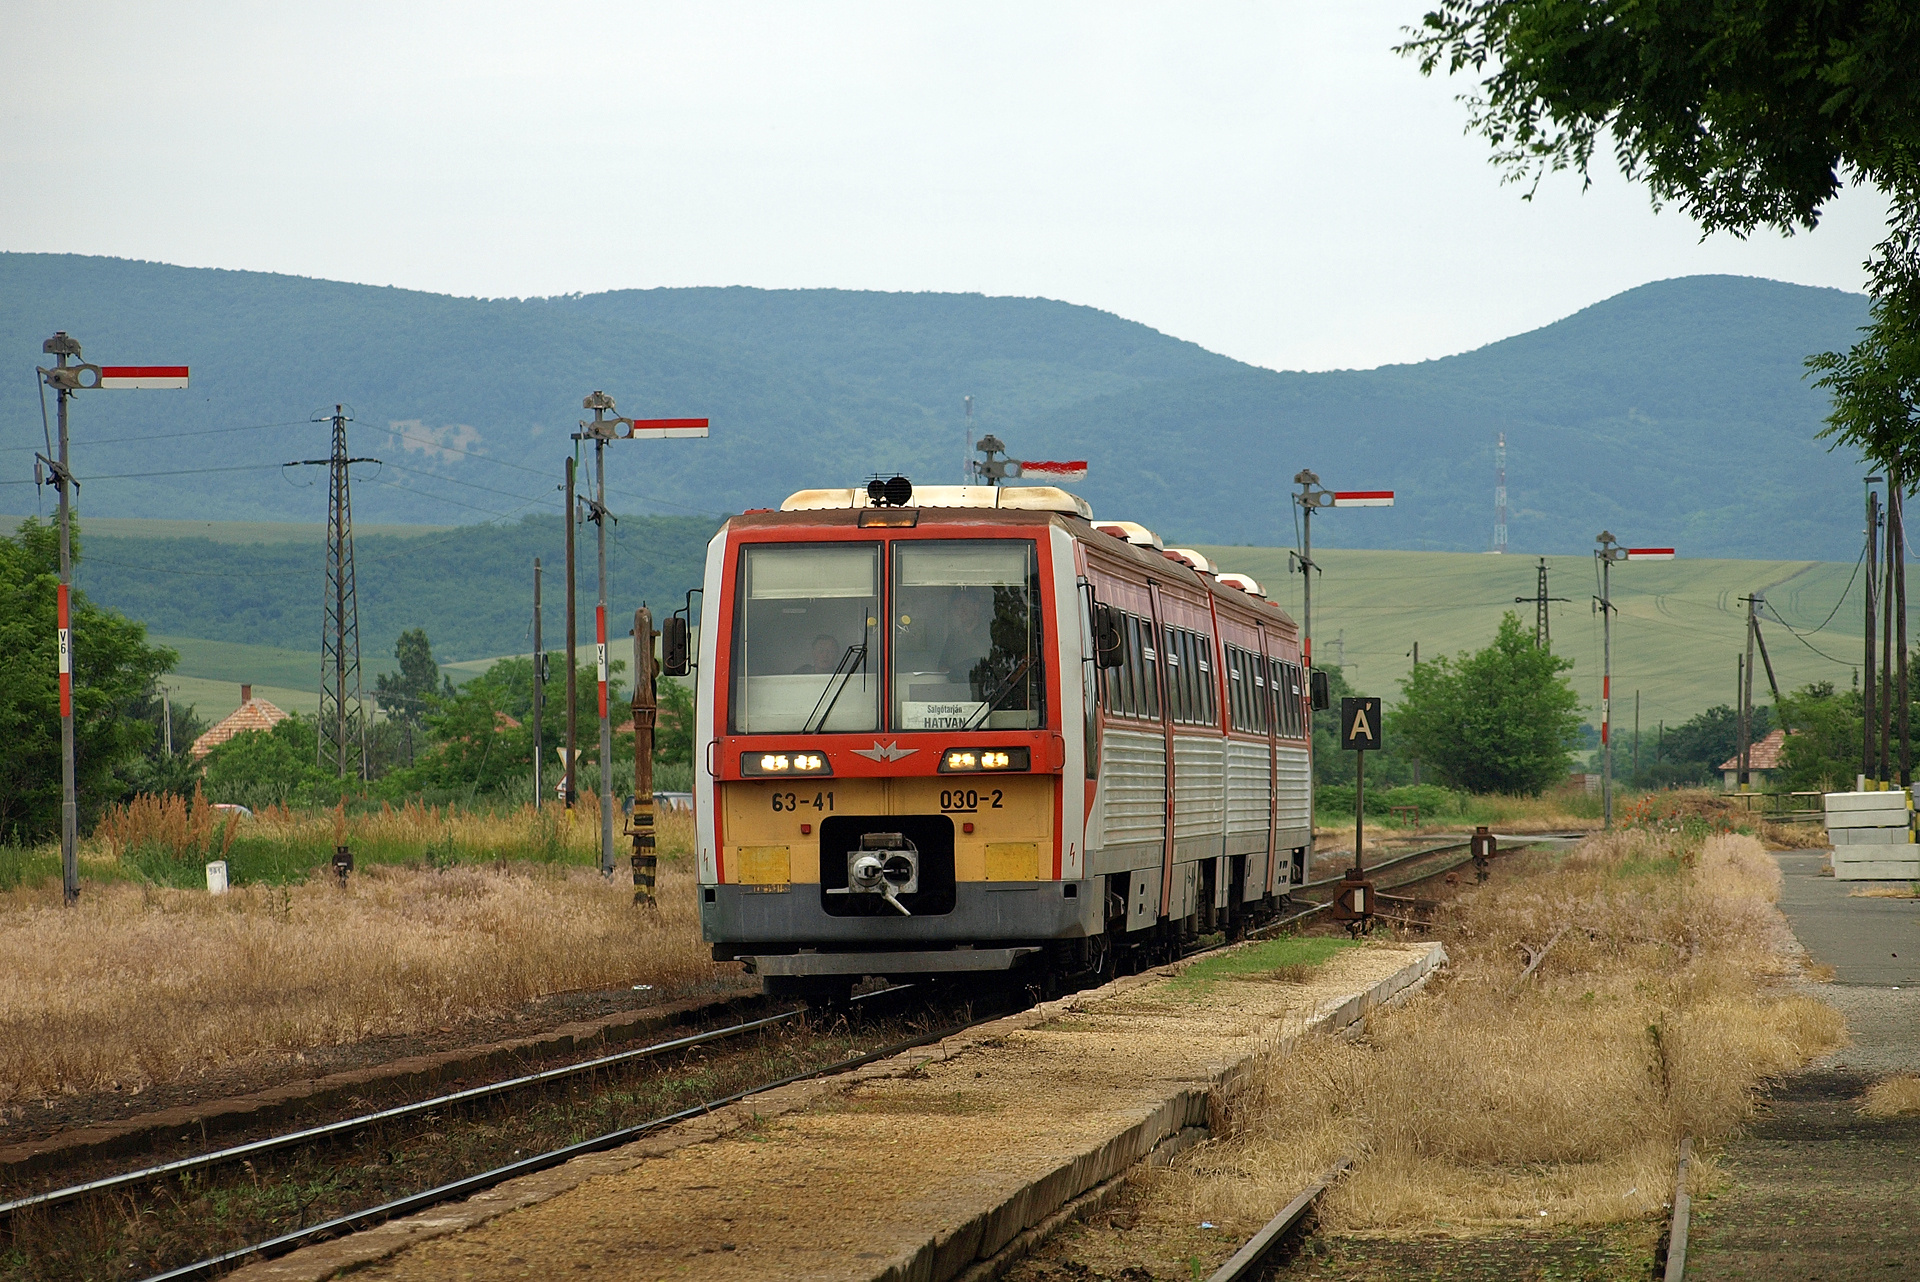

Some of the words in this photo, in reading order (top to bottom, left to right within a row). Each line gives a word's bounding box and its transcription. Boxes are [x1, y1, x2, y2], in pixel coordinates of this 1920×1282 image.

[927, 704, 963, 715] Salgótarján
[924, 717, 966, 728] HATVAN
[1349, 702, 1373, 740] Á
[771, 791, 834, 812] 63-41
[940, 789, 1004, 809] 030-2
